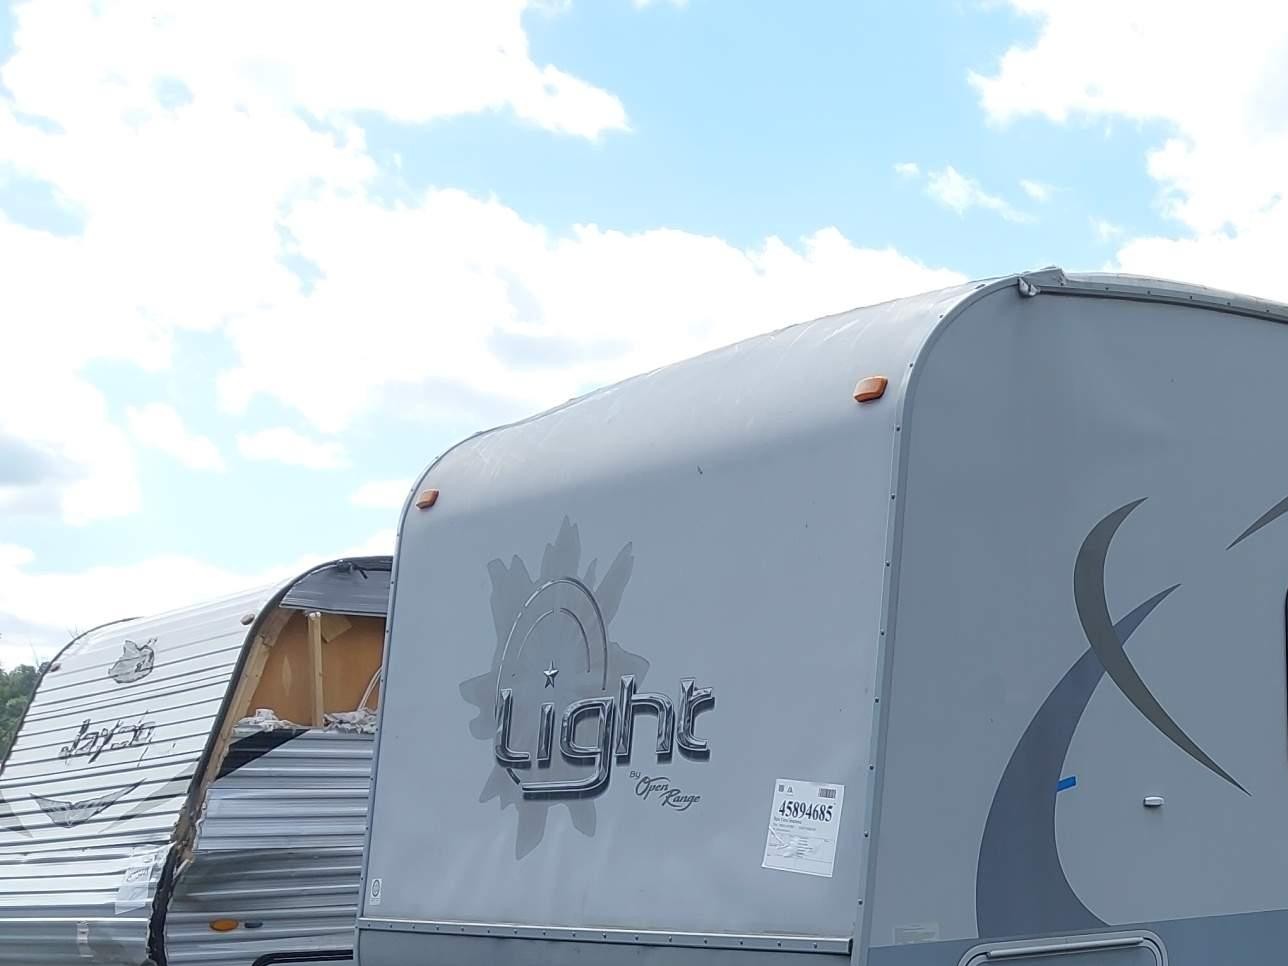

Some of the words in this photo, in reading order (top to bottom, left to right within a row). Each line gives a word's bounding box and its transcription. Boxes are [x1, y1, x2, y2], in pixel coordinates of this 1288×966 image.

[496, 674, 714, 799] Light
[635, 776, 671, 800] Open
[659, 788, 701, 811] Range
[778, 800, 834, 822] 45894685
